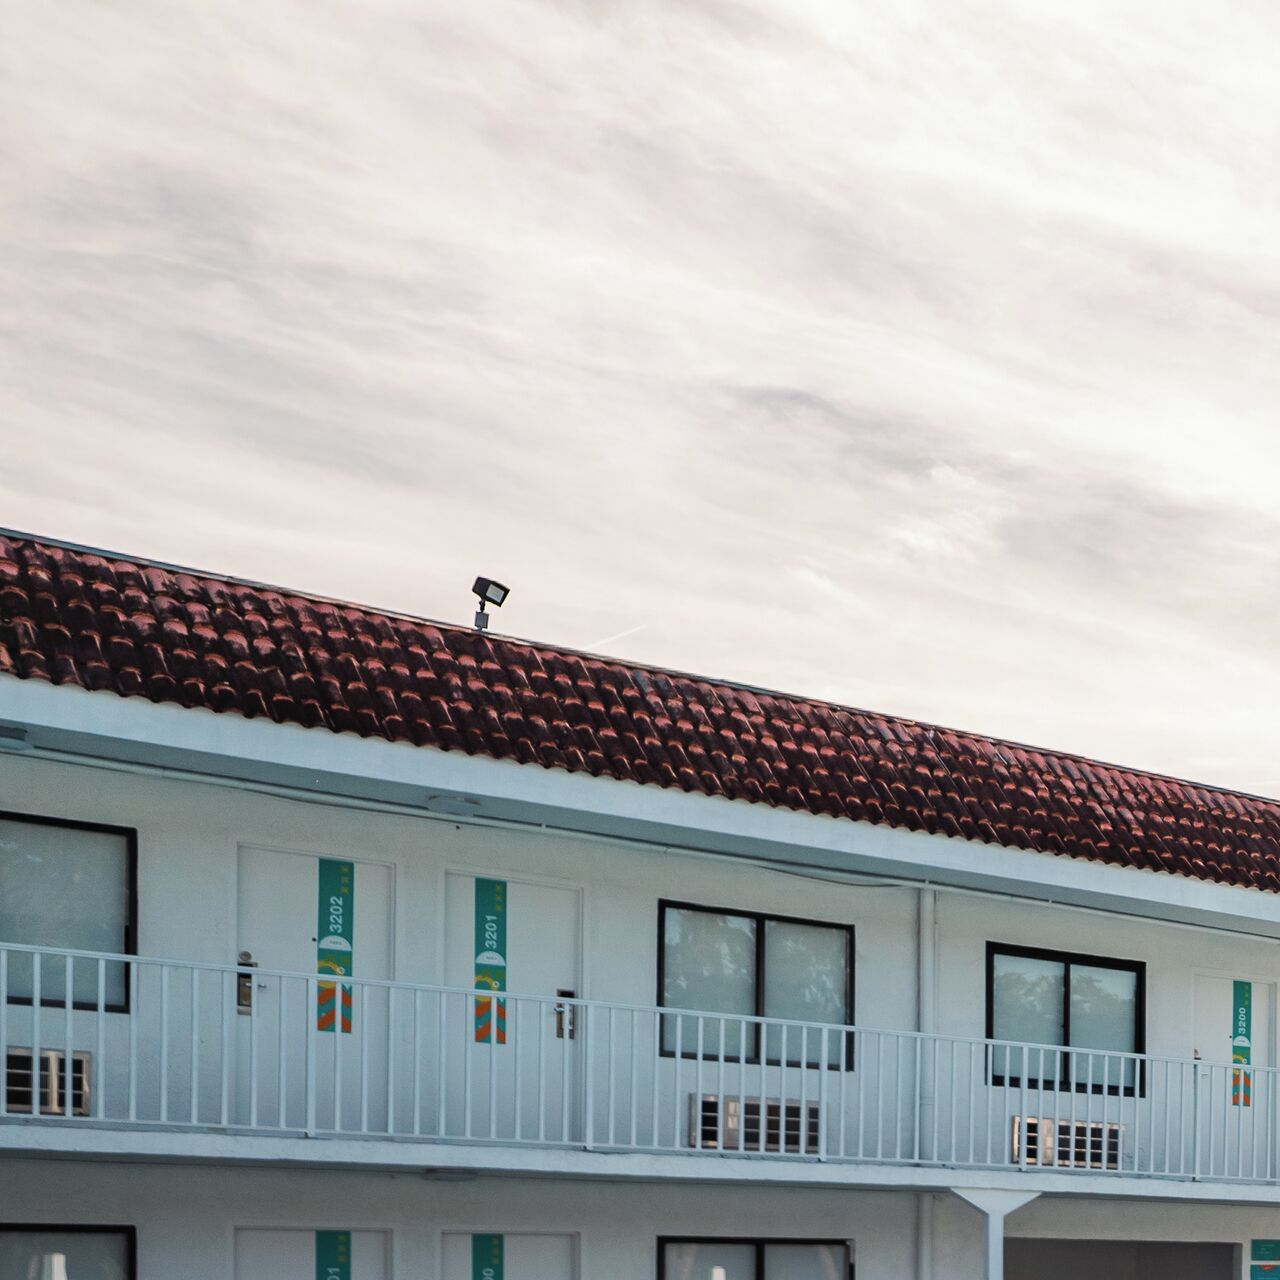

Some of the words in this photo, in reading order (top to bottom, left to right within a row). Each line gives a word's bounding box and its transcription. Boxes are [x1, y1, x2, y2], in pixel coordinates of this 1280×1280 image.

[330, 895, 343, 934] 3202
[485, 914, 498, 949] 3201
[1238, 1007, 1246, 1035] 3200
